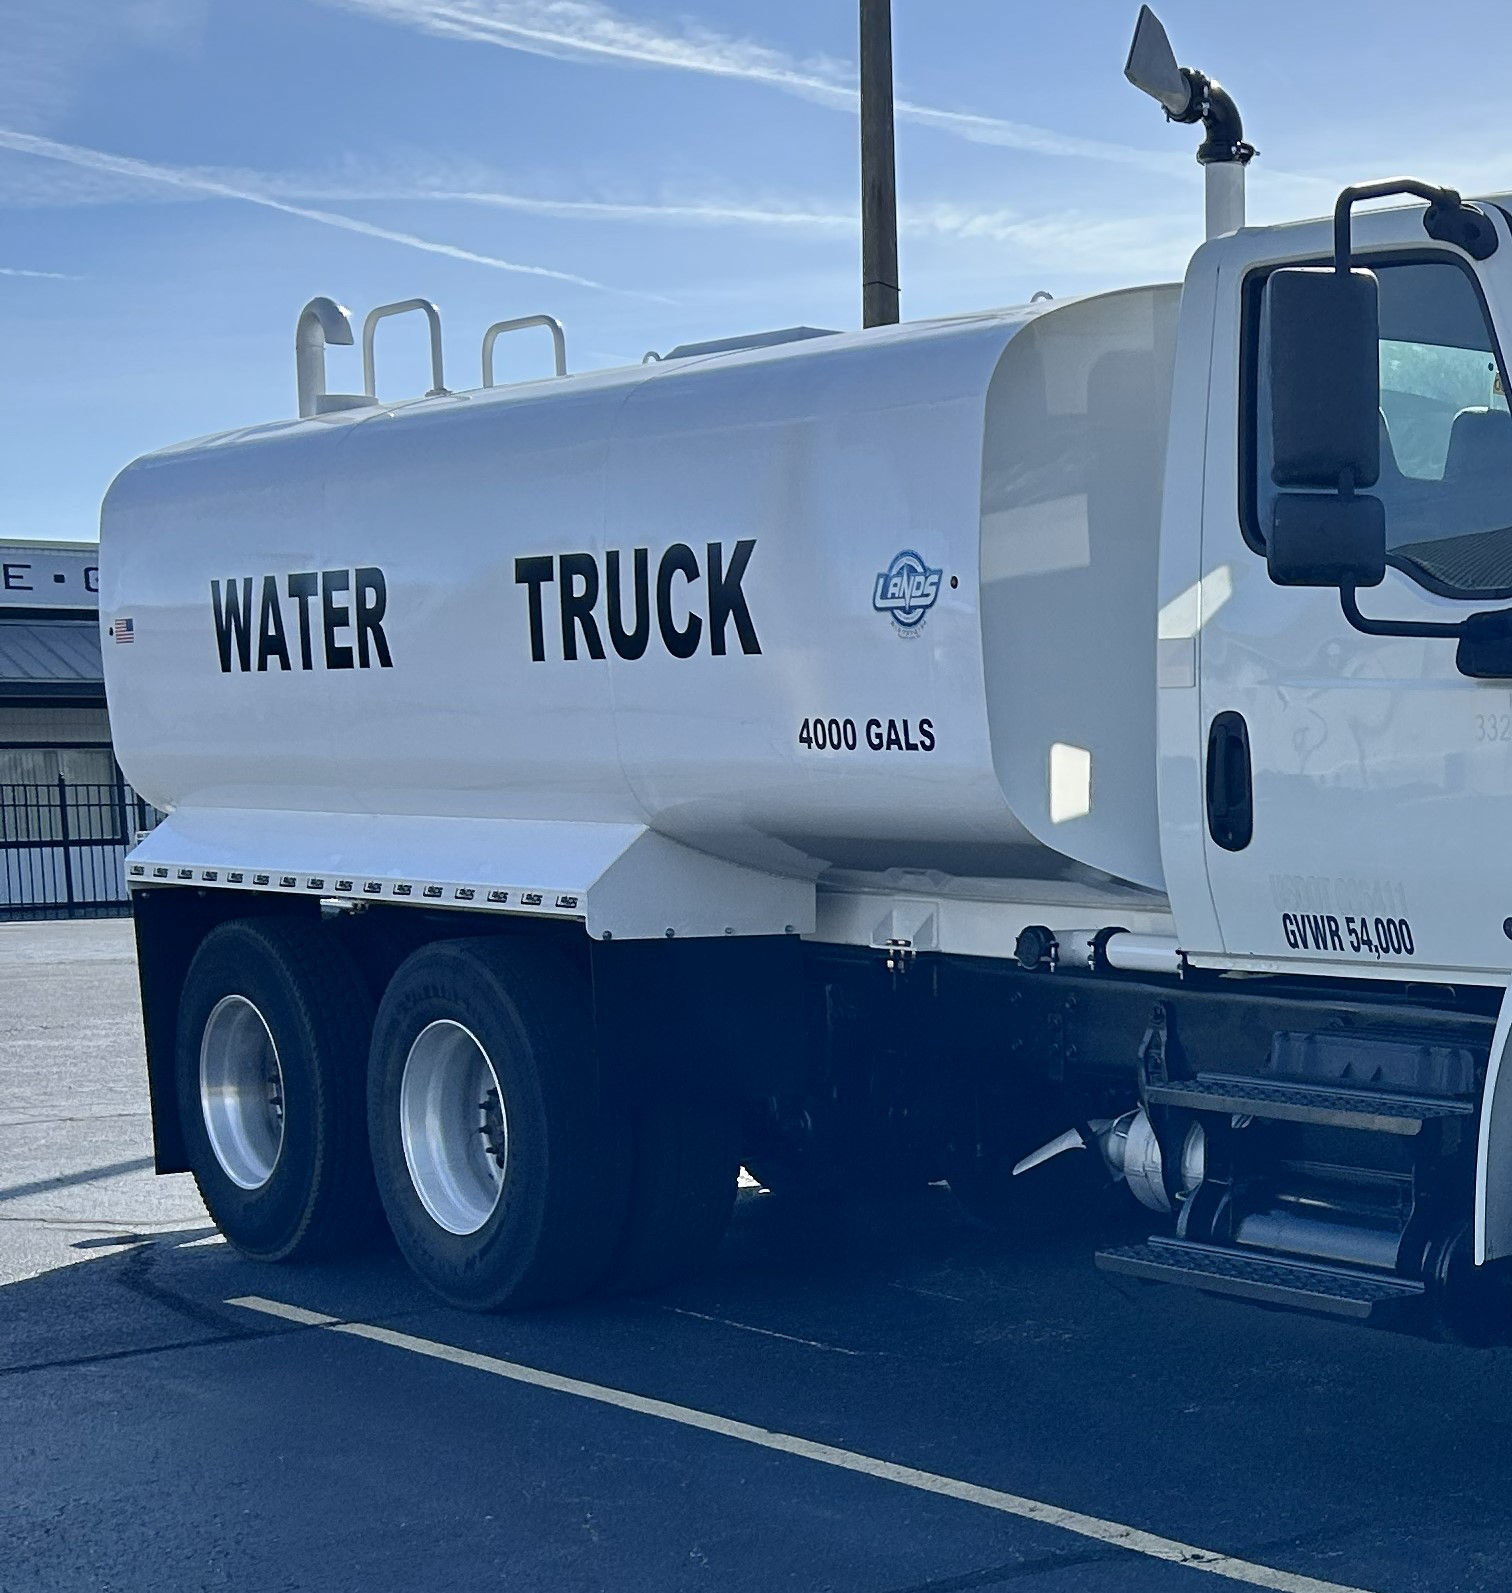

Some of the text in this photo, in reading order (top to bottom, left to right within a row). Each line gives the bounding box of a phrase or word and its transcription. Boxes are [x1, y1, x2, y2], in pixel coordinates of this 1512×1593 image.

[210, 567, 394, 673] WATER
[514, 539, 763, 662] TRUCK
[798, 717, 936, 752] 4000 GALS
[1282, 912, 1415, 960] GVWR 54,000
